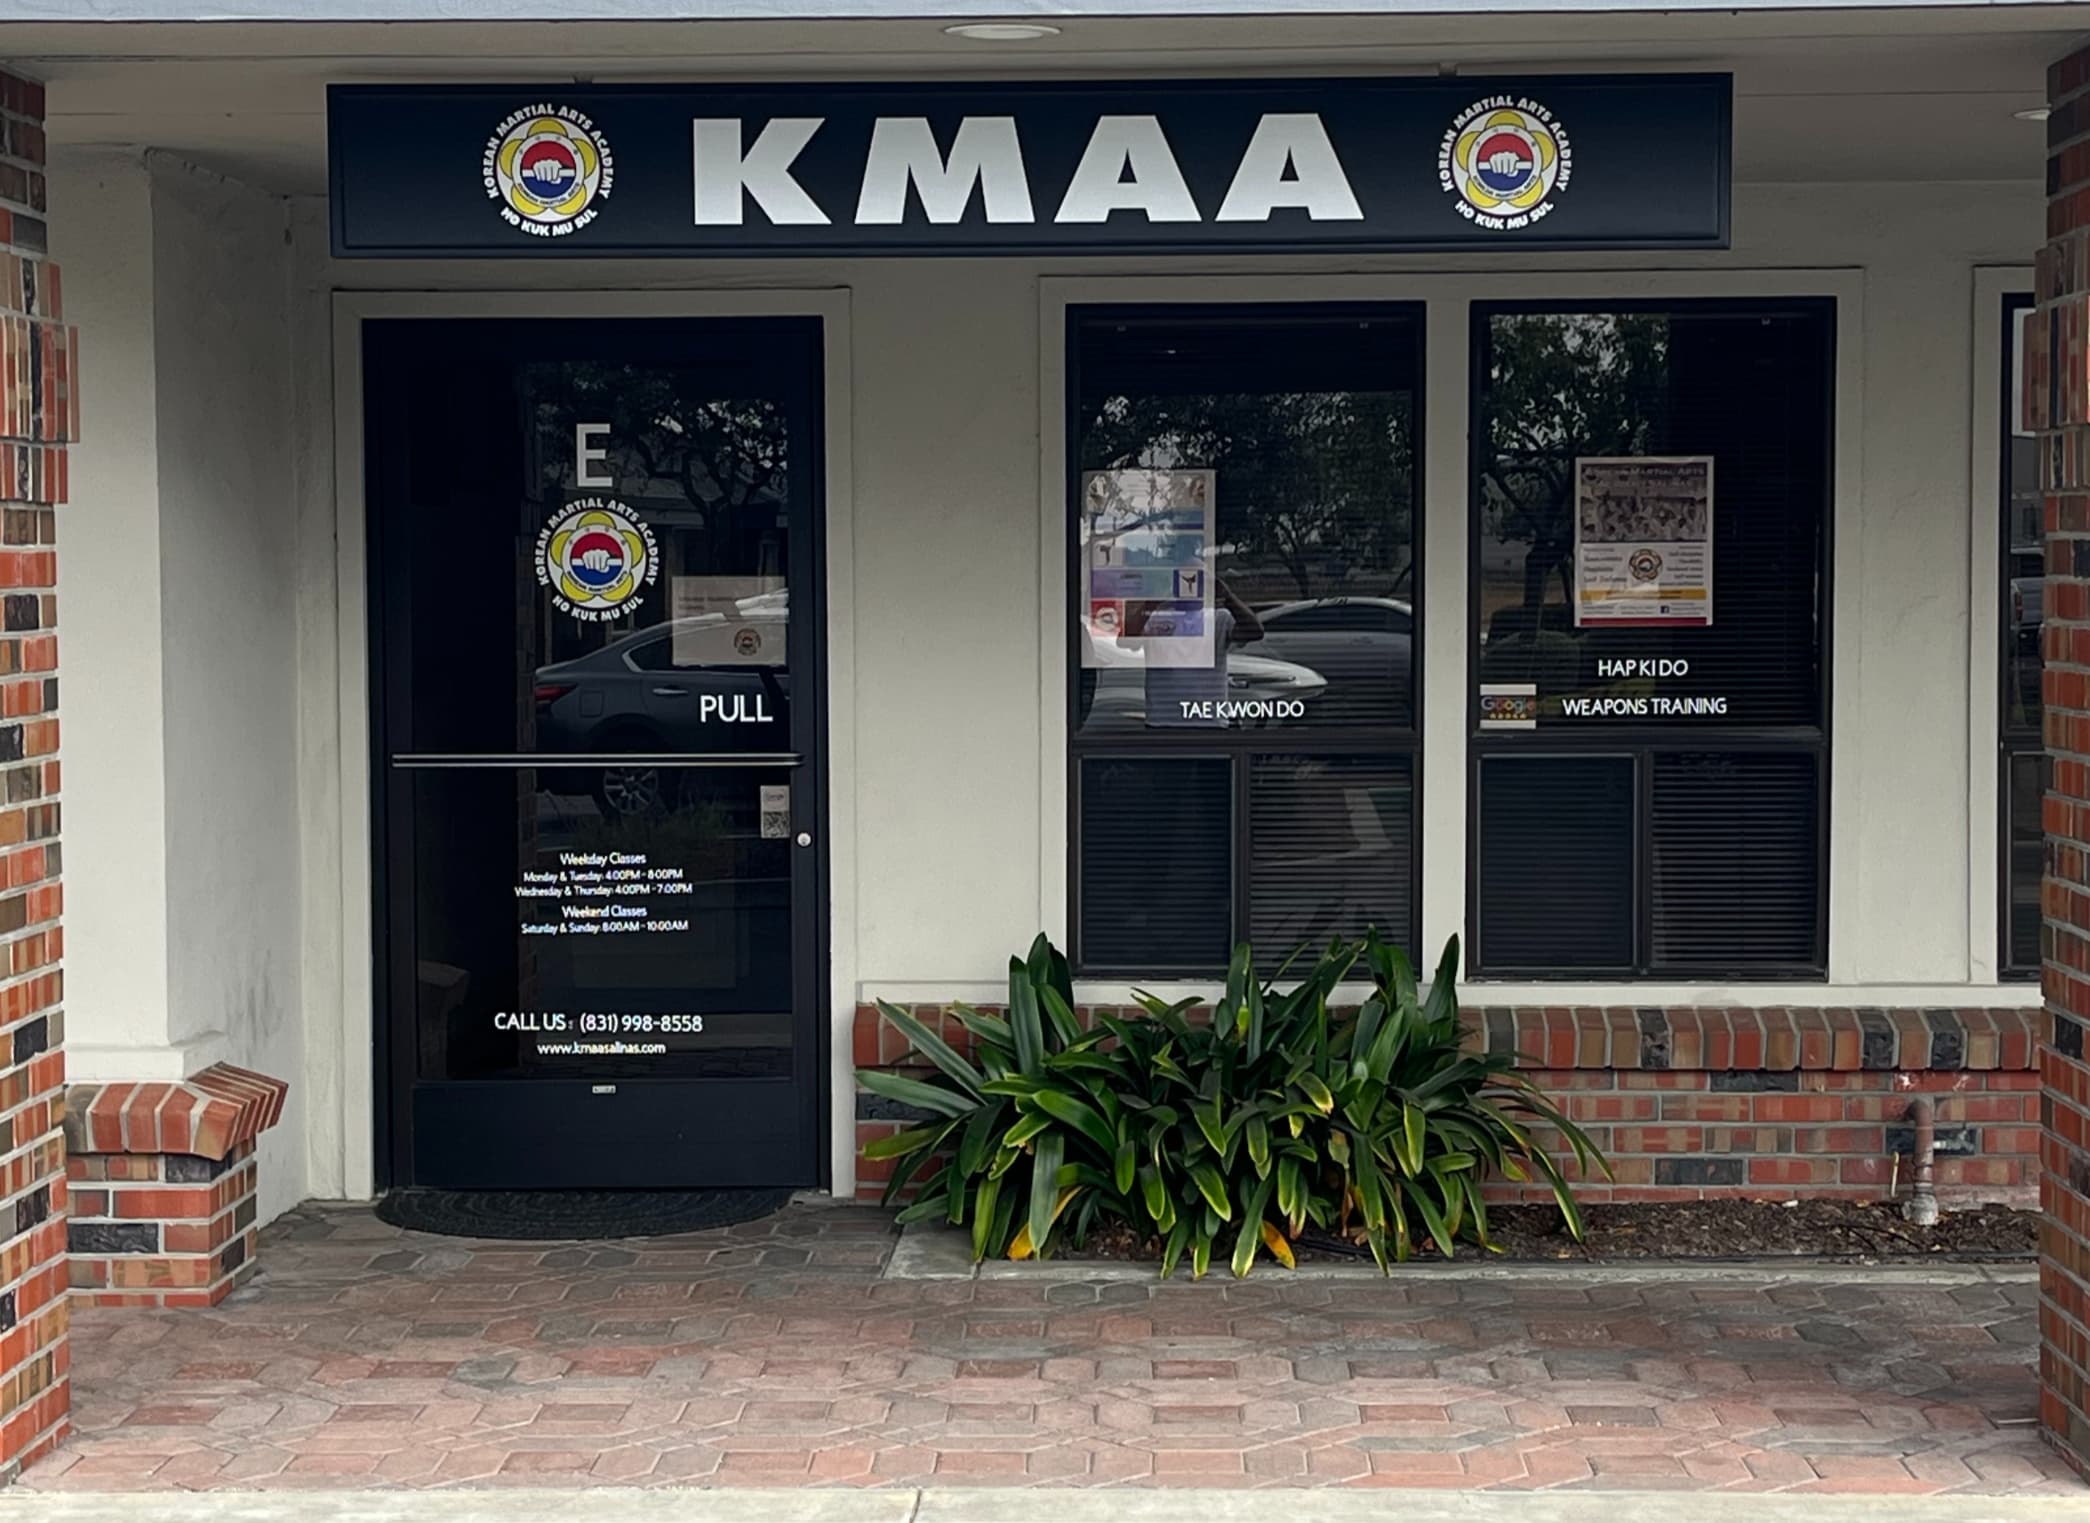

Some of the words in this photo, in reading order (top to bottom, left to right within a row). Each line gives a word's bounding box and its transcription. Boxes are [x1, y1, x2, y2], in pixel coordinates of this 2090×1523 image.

[483, 136, 500, 199] KOREAN
[496, 104, 555, 137] MARTIAL
[558, 105, 593, 131] ARTS
[591, 131, 614, 199] ACADEMY
[1438, 129, 1457, 193] KOREAN
[1453, 96, 1514, 129] MARTIAL
[1517, 97, 1553, 123] ARTS
[1550, 122, 1572, 193] ACADEMY
[693, 113, 1364, 225] KMAA
[500, 207, 520, 226] HO
[521, 223, 550, 237] KUK
[552, 223, 574, 237] MU
[575, 209, 599, 229] SUL
[1455, 200, 1475, 219] HO
[1475, 216, 1504, 230] KUK
[1506, 216, 1529, 229] MU
[1530, 202, 1554, 221] SUL
[577, 423, 613, 487] E
[534, 528, 551, 586] KOREAN
[548, 497, 604, 529] MARTIAL
[607, 499, 640, 522] ARTS
[637, 522, 660, 587] ACADEMY
[552, 595, 570, 613] HO
[571, 609, 598, 622] KUK
[601, 609, 621, 622] MU
[622, 596, 644, 614] SUL
[700, 694, 773, 723] PULL
[1180, 702, 1212, 719] TAE
[1481, 696, 1536, 714] Google
[1563, 699, 1648, 716] WEAPONS
[1651, 698, 1727, 715] TRAINING
[560, 853, 608, 867] Weekday
[609, 852, 647, 865] Classes
[524, 871, 558, 883] Monday
[560, 871, 568, 881] &
[514, 886, 563, 898] Wednesday
[564, 886, 572, 896] &
[562, 906, 609, 918] Weekend
[611, 906, 647, 917] Classes
[521, 923, 558, 935] Saturday
[559, 923, 567, 933] &
[494, 1013, 540, 1030] CALL
[580, 1013, 618, 1033] (831)
[622, 1015, 703, 1032] 998-8558
[537, 1041, 666, 1054] www.kmaasalinas.com
